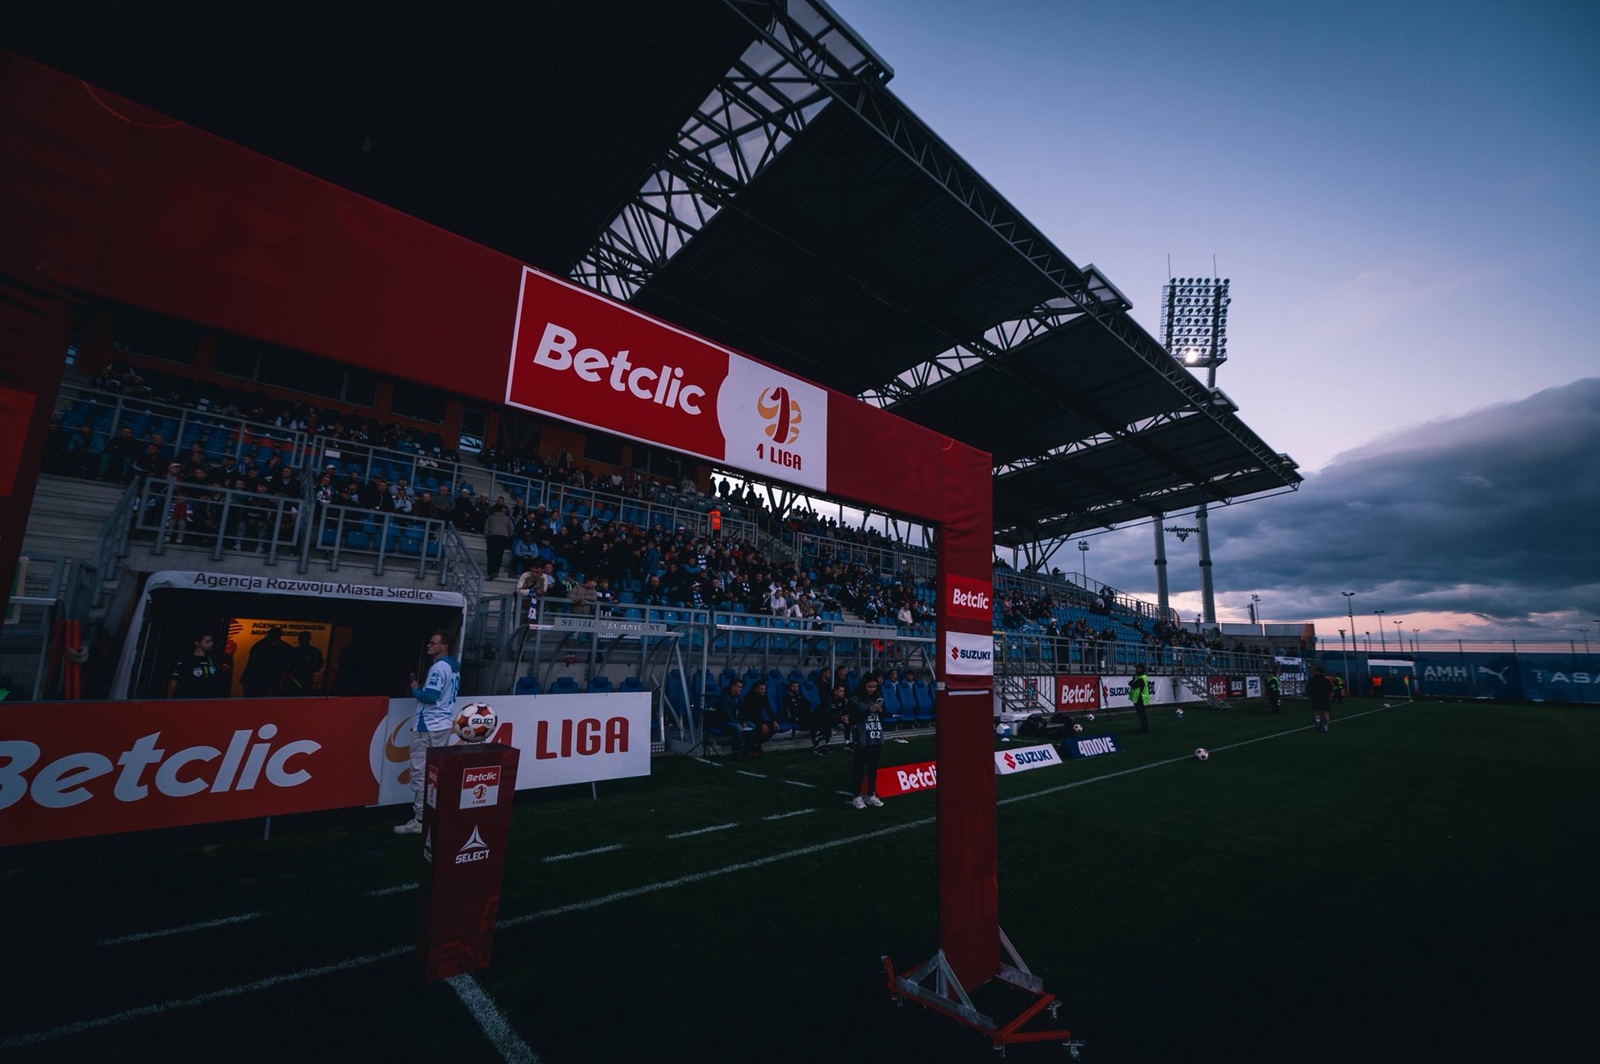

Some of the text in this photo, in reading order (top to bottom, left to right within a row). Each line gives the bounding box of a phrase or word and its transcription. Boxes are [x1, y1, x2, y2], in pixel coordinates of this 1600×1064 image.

[532, 322, 706, 415] Betclic
[756, 443, 802, 471] 1 LIGA
[194, 573, 433, 600] Agencja Rozwoju Miasta Siedlce
[952, 588, 990, 610] Betclic
[960, 649, 991, 661] SUZUKI
[1424, 665, 1468, 677] AMH
[1061, 683, 1096, 704] Betclic
[1109, 686, 1131, 698] SUZUK
[471, 718, 494, 726] SELECT
[535, 716, 629, 760] LIGA
[1077, 737, 1117, 757] 4MOVE
[0, 723, 323, 811] Betclic
[1015, 749, 1053, 765] SUZUKI
[465, 771, 498, 782] Betclic
[896, 764, 937, 791] Betcli
[455, 849, 490, 865] SELECT
